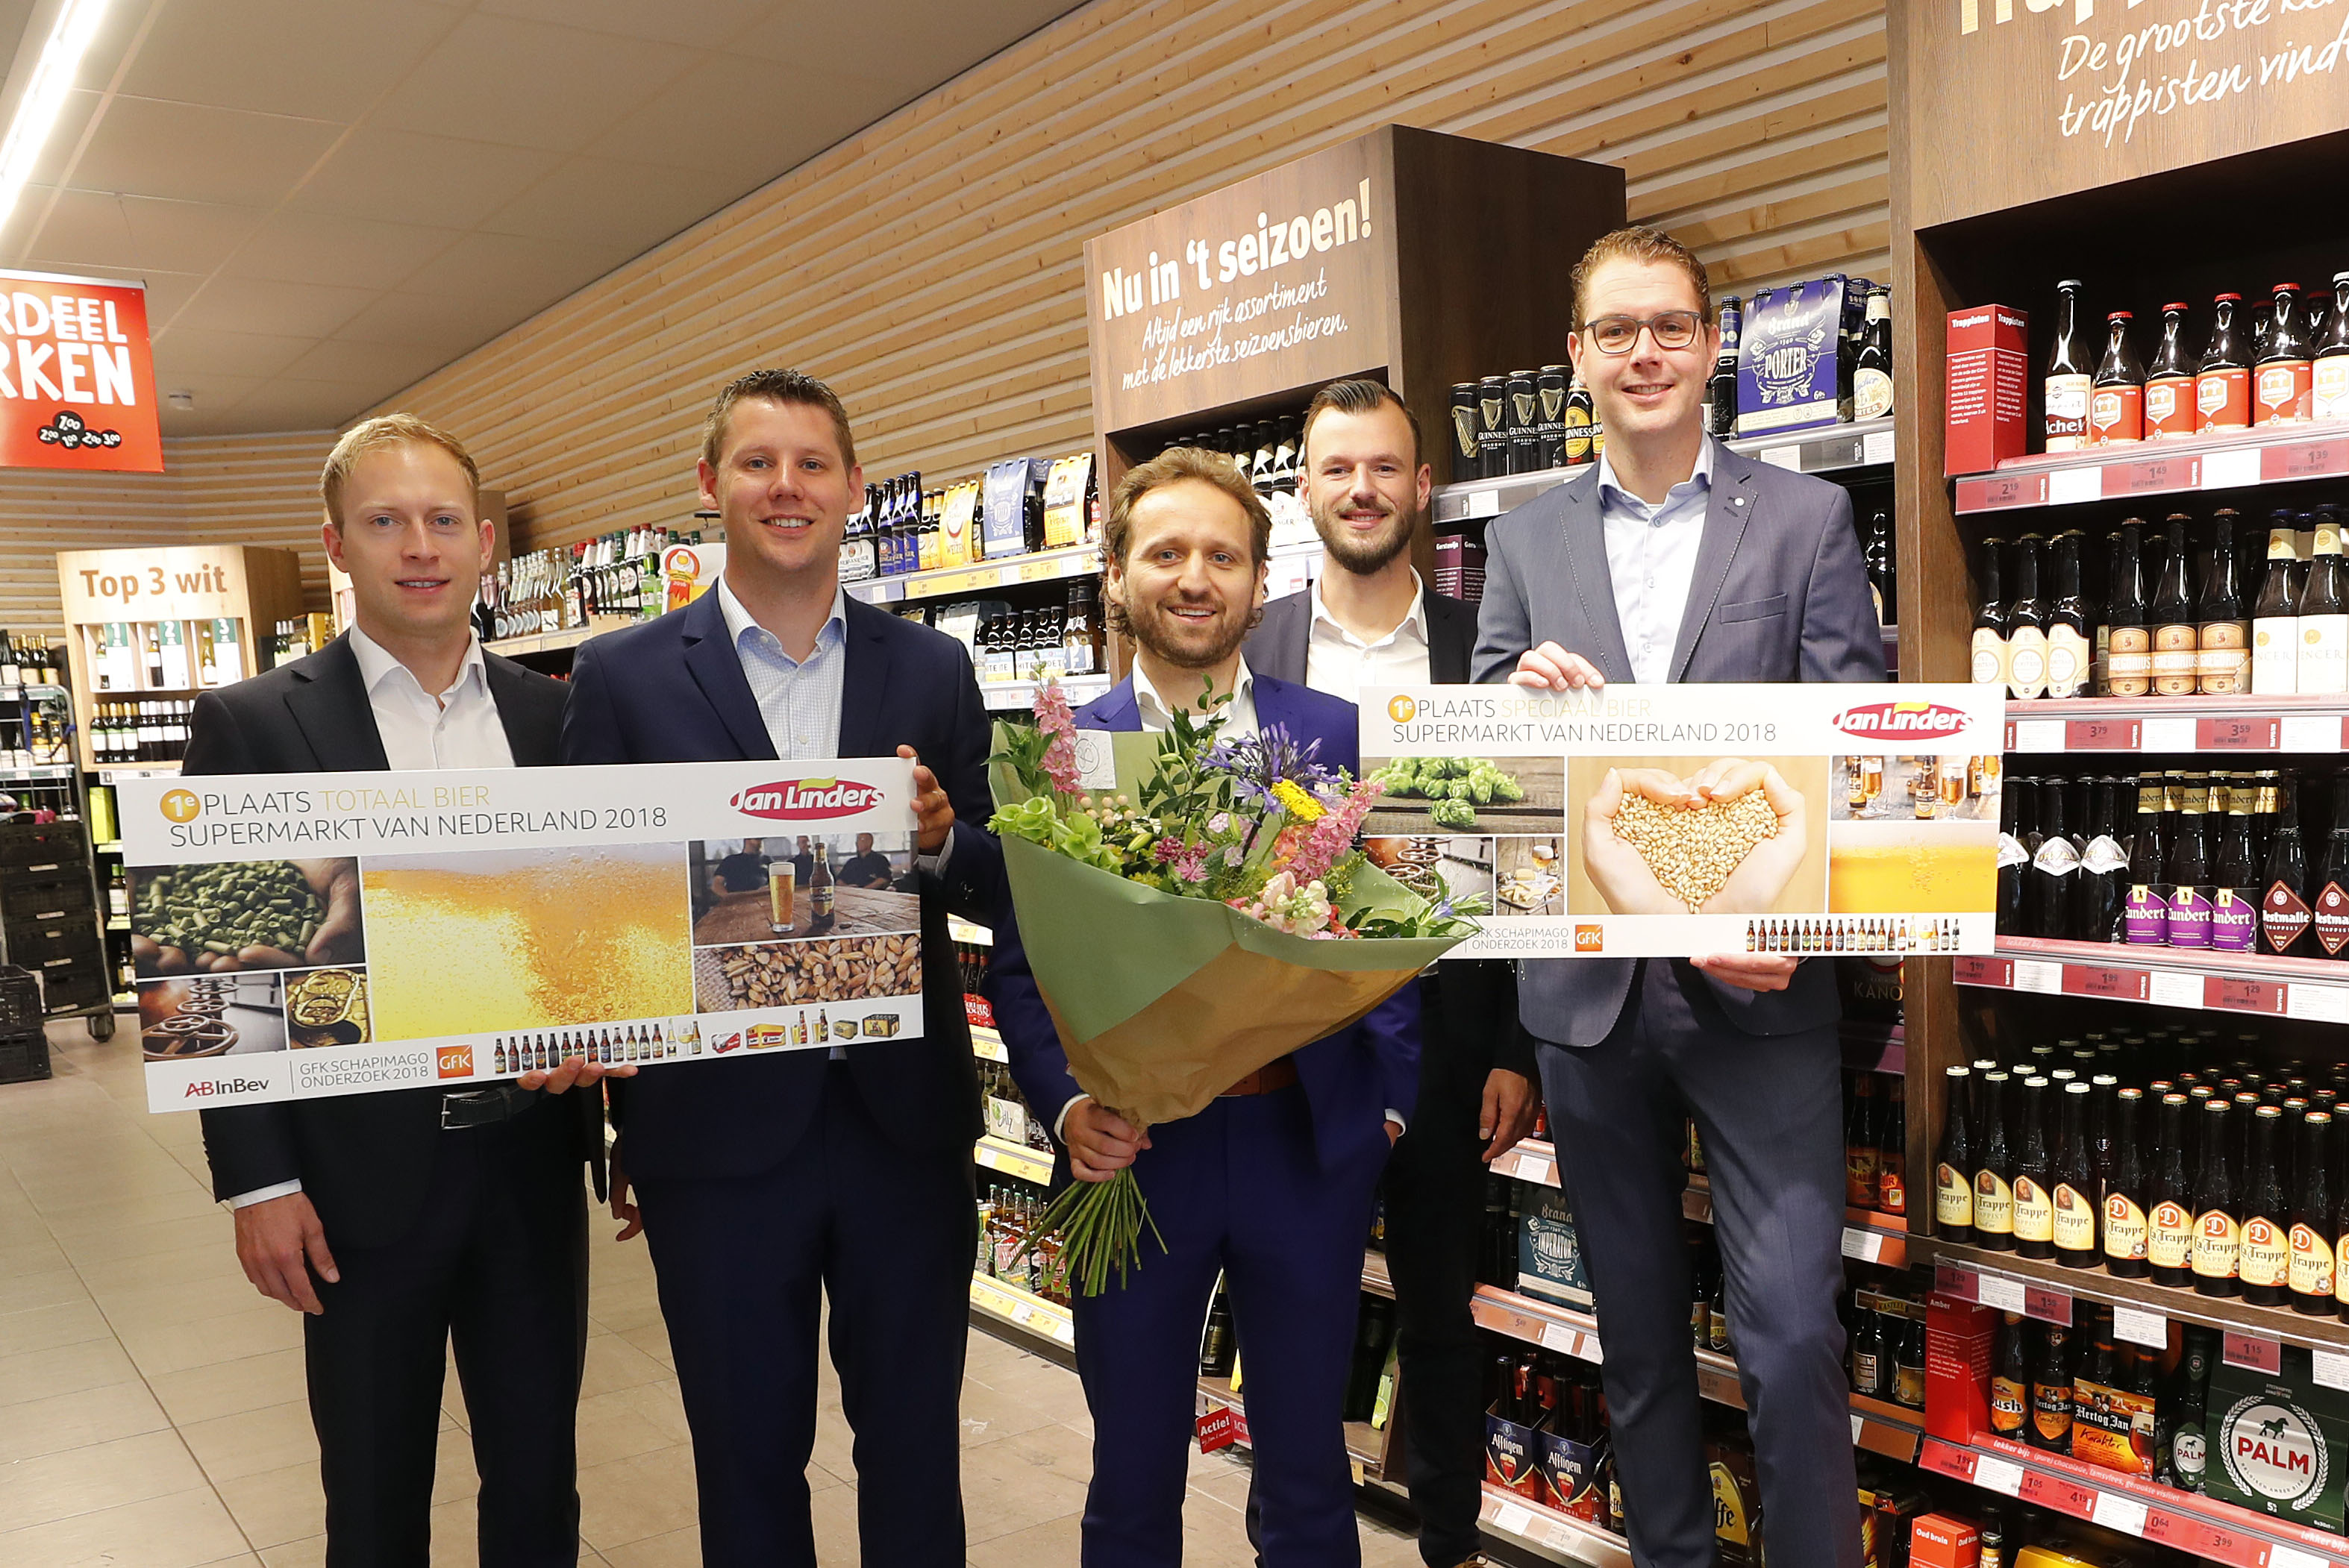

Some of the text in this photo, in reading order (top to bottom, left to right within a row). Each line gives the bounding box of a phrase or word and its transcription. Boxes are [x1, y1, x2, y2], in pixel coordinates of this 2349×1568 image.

[2057, 34, 2109, 81] De
[2101, 0, 2270, 95] grootste
[2058, 59, 2252, 148] trappisten
[1102, 266, 1144, 321] Nu
[1149, 251, 1180, 306] in
[1218, 177, 1372, 283] seizoen!
[1142, 267, 1328, 361] Altijd een rijk assortiment
[1767, 311, 1811, 336] Brand
[1951, 314, 1990, 328] Trappisten
[1998, 313, 2025, 327] Trappisten
[1122, 310, 1349, 392] met de lekkerste seizoensbieren.
[1763, 347, 1807, 380] PORTER
[1509, 426, 1538, 436] GUINNE
[1566, 427, 1593, 439] INNESS
[79, 563, 228, 604] Top 3 wit
[2300, 649, 2345, 660] ENCER
[1419, 699, 1496, 718] PLAATS
[1501, 699, 1601, 718] SPECIAAL
[1607, 698, 1651, 717] BIER
[1834, 706, 1974, 731] Jan Linders
[1392, 723, 1777, 743] SUPERMARKT VAN NEDERLAND 2018
[203, 791, 312, 816] PLAATS
[318, 787, 426, 812] TOTAAL
[433, 785, 490, 807] BIER
[731, 782, 886, 811] Jan Linders
[2139, 792, 2162, 805] ndert
[2230, 794, 2253, 805] ndert
[169, 806, 668, 848] SUPERMARKT VAN NEDERLAND 2018
[2212, 909, 2251, 925] undert
[2315, 911, 2349, 925] estma
[1495, 927, 1569, 938] SCHAPIMAGO
[1471, 938, 1568, 950] ONDERZOEK 2018
[1854, 979, 1904, 1002] KANO
[299, 1052, 429, 1076] GFK SCHAPIMAGO
[183, 1076, 269, 1099] ABInBev
[300, 1065, 429, 1089] ONDERZOEK 2018
[1977, 1195, 2011, 1211] Trappe
[2015, 1202, 2049, 1219] Trappe
[2056, 1210, 2089, 1228] Trappe
[2106, 1219, 2145, 1236] Trappe
[1538, 1231, 1572, 1259] IMPERATOR
[2248, 1245, 2287, 1263] Trappe
[2291, 1251, 2329, 1270] Trappe
[1930, 1298, 1951, 1311] Amber
[1200, 1414, 1230, 1437] Actie!
[2074, 1405, 2130, 1431] Hertog Jan
[1491, 1433, 1524, 1457] Affligem
[2080, 1428, 2124, 1449] Karakter
[1548, 1451, 1582, 1475] Affligem
[2177, 1448, 2206, 1460] PALM
[2238, 1436, 2309, 1475] PALM
[1993, 1439, 2017, 1453] lekker
[2017, 1444, 2030, 1458] bij:
[2033, 1451, 2054, 1464] (pure)
[2053, 1458, 2089, 1476] chocolade,
[2089, 1466, 2124, 1486] lamsvlees,
[2124, 1478, 2156, 1496] gerookte
[1715, 1496, 1736, 1528] ffe
[1915, 1528, 1949, 1546] Oud bruin
[1968, 1534, 1977, 1545] bru
[2300, 1530, 2331, 1546] lekker
